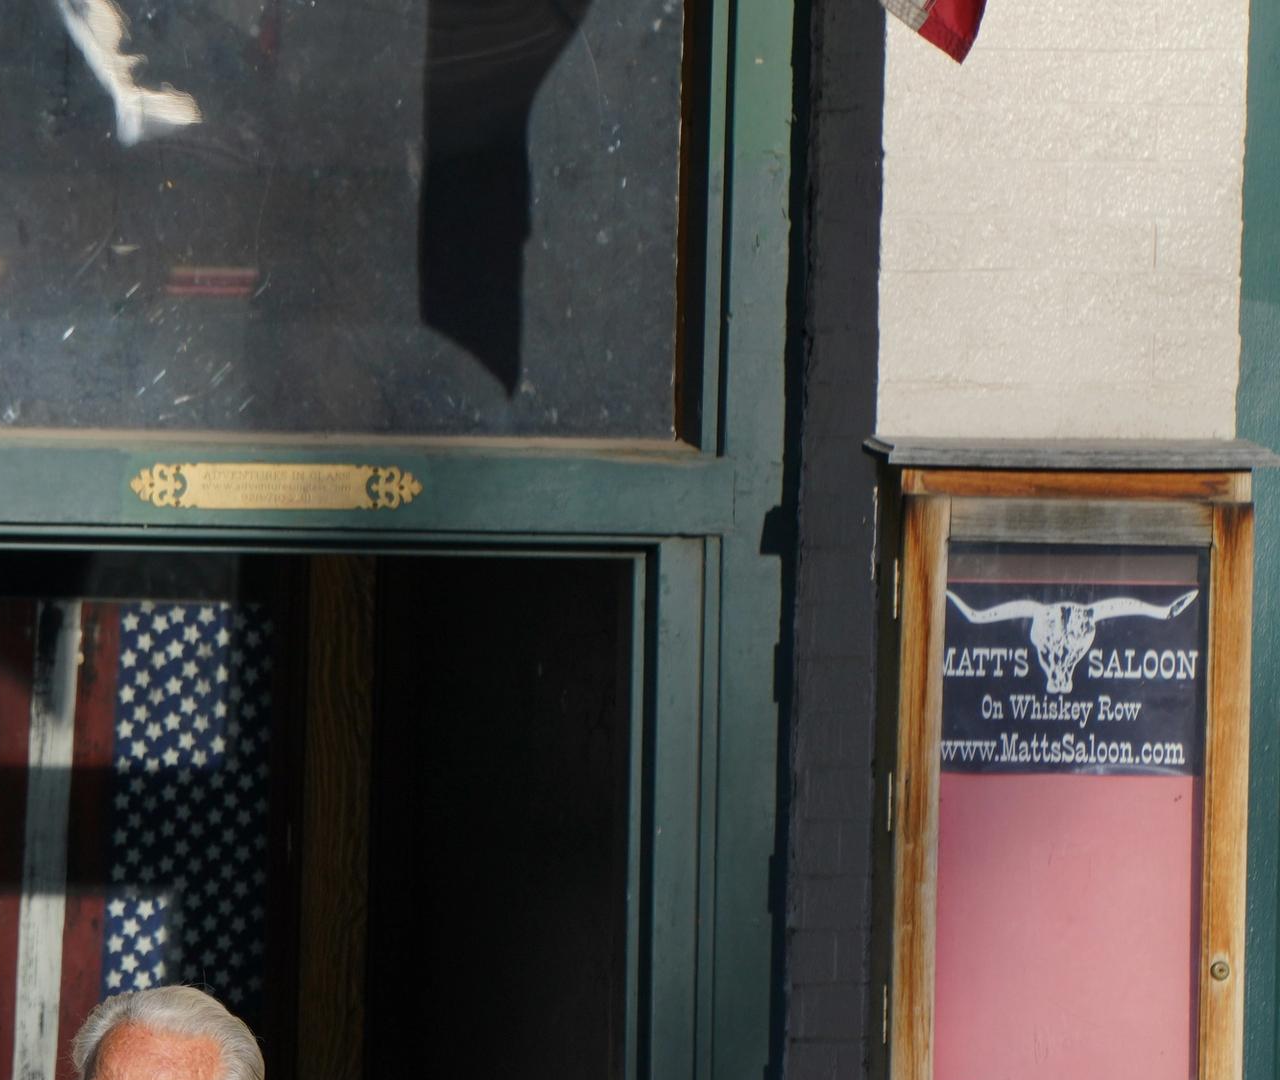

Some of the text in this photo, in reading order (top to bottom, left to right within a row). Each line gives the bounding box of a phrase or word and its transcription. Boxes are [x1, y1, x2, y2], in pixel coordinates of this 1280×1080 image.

[1088, 649, 1199, 680] SALOON
[981, 694, 1141, 728] On Whiskey Row
[941, 733, 1186, 765] www.MattsSaloon.com
